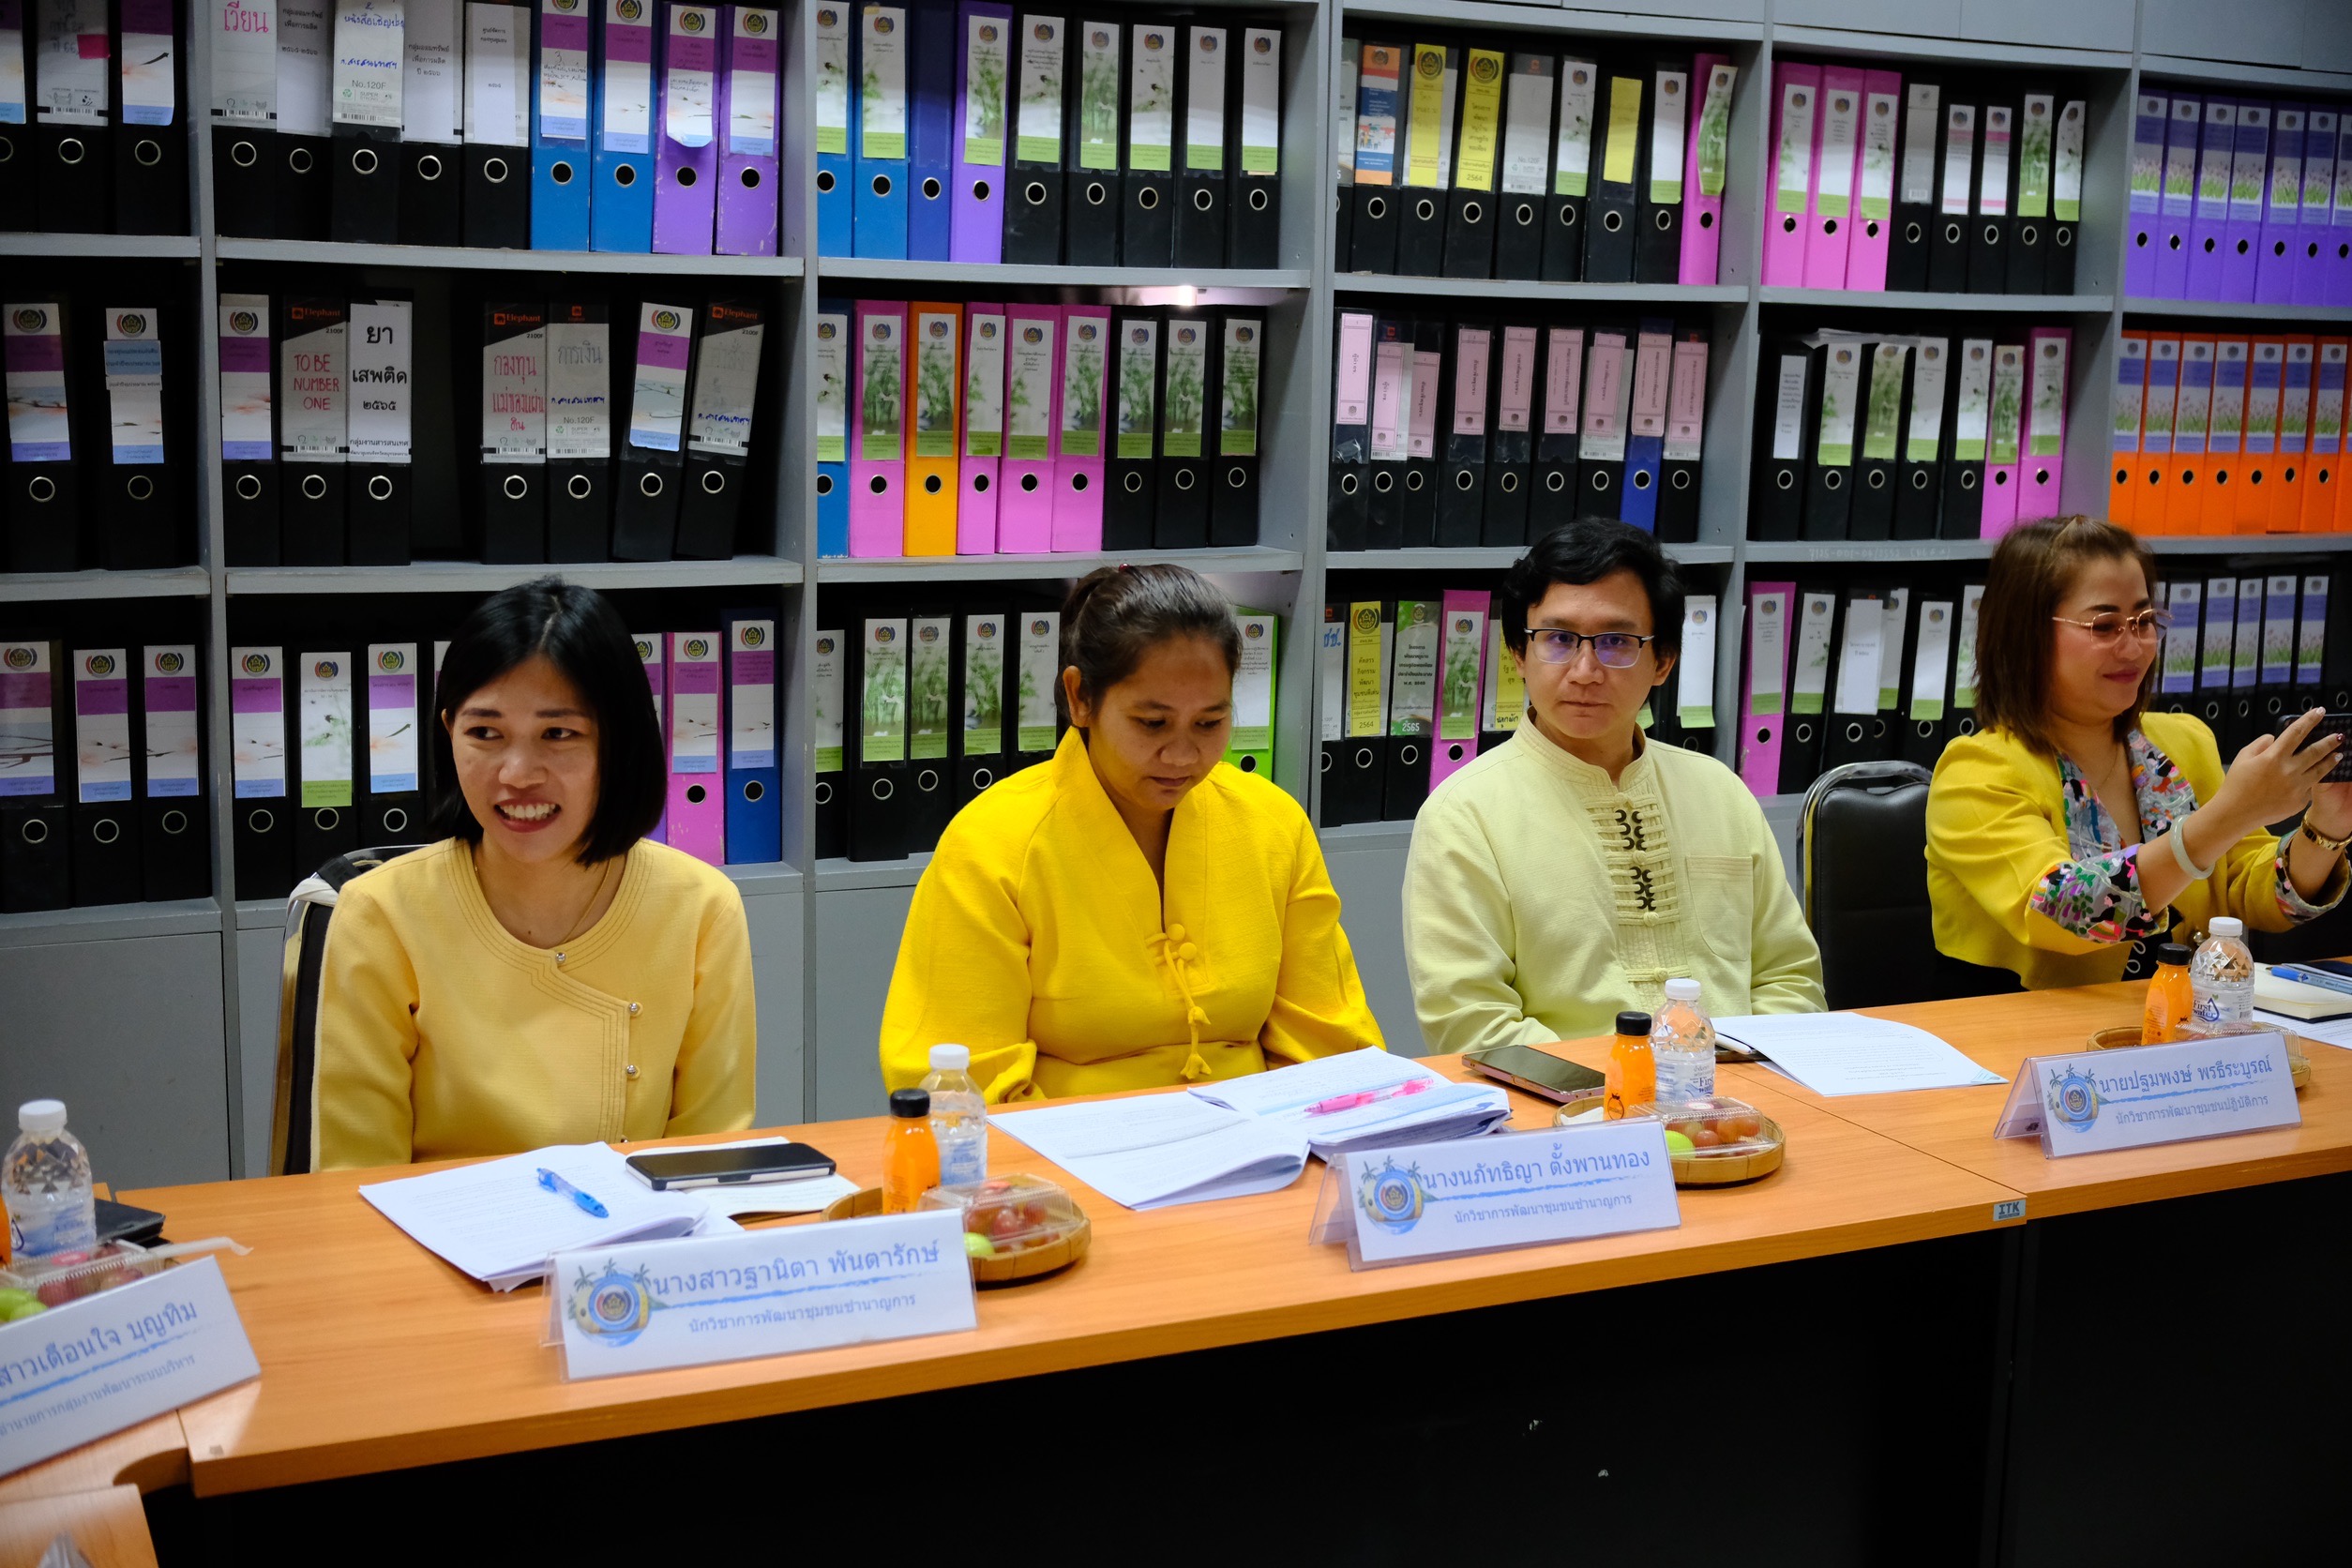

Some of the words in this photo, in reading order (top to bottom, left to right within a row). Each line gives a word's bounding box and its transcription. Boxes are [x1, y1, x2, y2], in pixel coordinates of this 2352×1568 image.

[352, 80, 386, 90] No.120F
[1466, 173, 1483, 182] 2564
[305, 308, 340, 318] Elephant
[506, 313, 541, 323] Elephant
[724, 308, 759, 320] Elephant
[367, 325, 393, 345] ยา
[557, 339, 603, 366] การเงิน
[294, 354, 310, 372] TO
[314, 354, 331, 372] BE
[493, 354, 537, 385] กองทุน
[353, 365, 407, 384] เสพติด
[294, 378, 339, 392] NUMBER
[303, 397, 331, 411] ONE
[363, 400, 397, 411] ๒๕๖๕
[564, 416, 596, 425] No.120F
[1402, 722, 1420, 731] 2565
[2193, 999, 2212, 1012] First
[2099, 1064, 2193, 1093] นายปฐมพงษ์
[2197, 1054, 2273, 1081] พรธีระบูรณ์
[2116, 1094, 2269, 1124] นักวิชาการพัฒนาชุมชนปฏิบัติการ
[1423, 1160, 1544, 1190] นางนภัทธิญา
[1549, 1142, 1651, 1177] ตั้งพานทอง
[1455, 1194, 1633, 1224] นักวิชาการพัฒนาชุมชนชำนาญการ
[1998, 1201, 2020, 1215] ITK
[688, 1293, 917, 1334] นักวิชาการพัฒนาชุมชนชำนาญการ
[127, 1302, 198, 1342] บุญทิม
